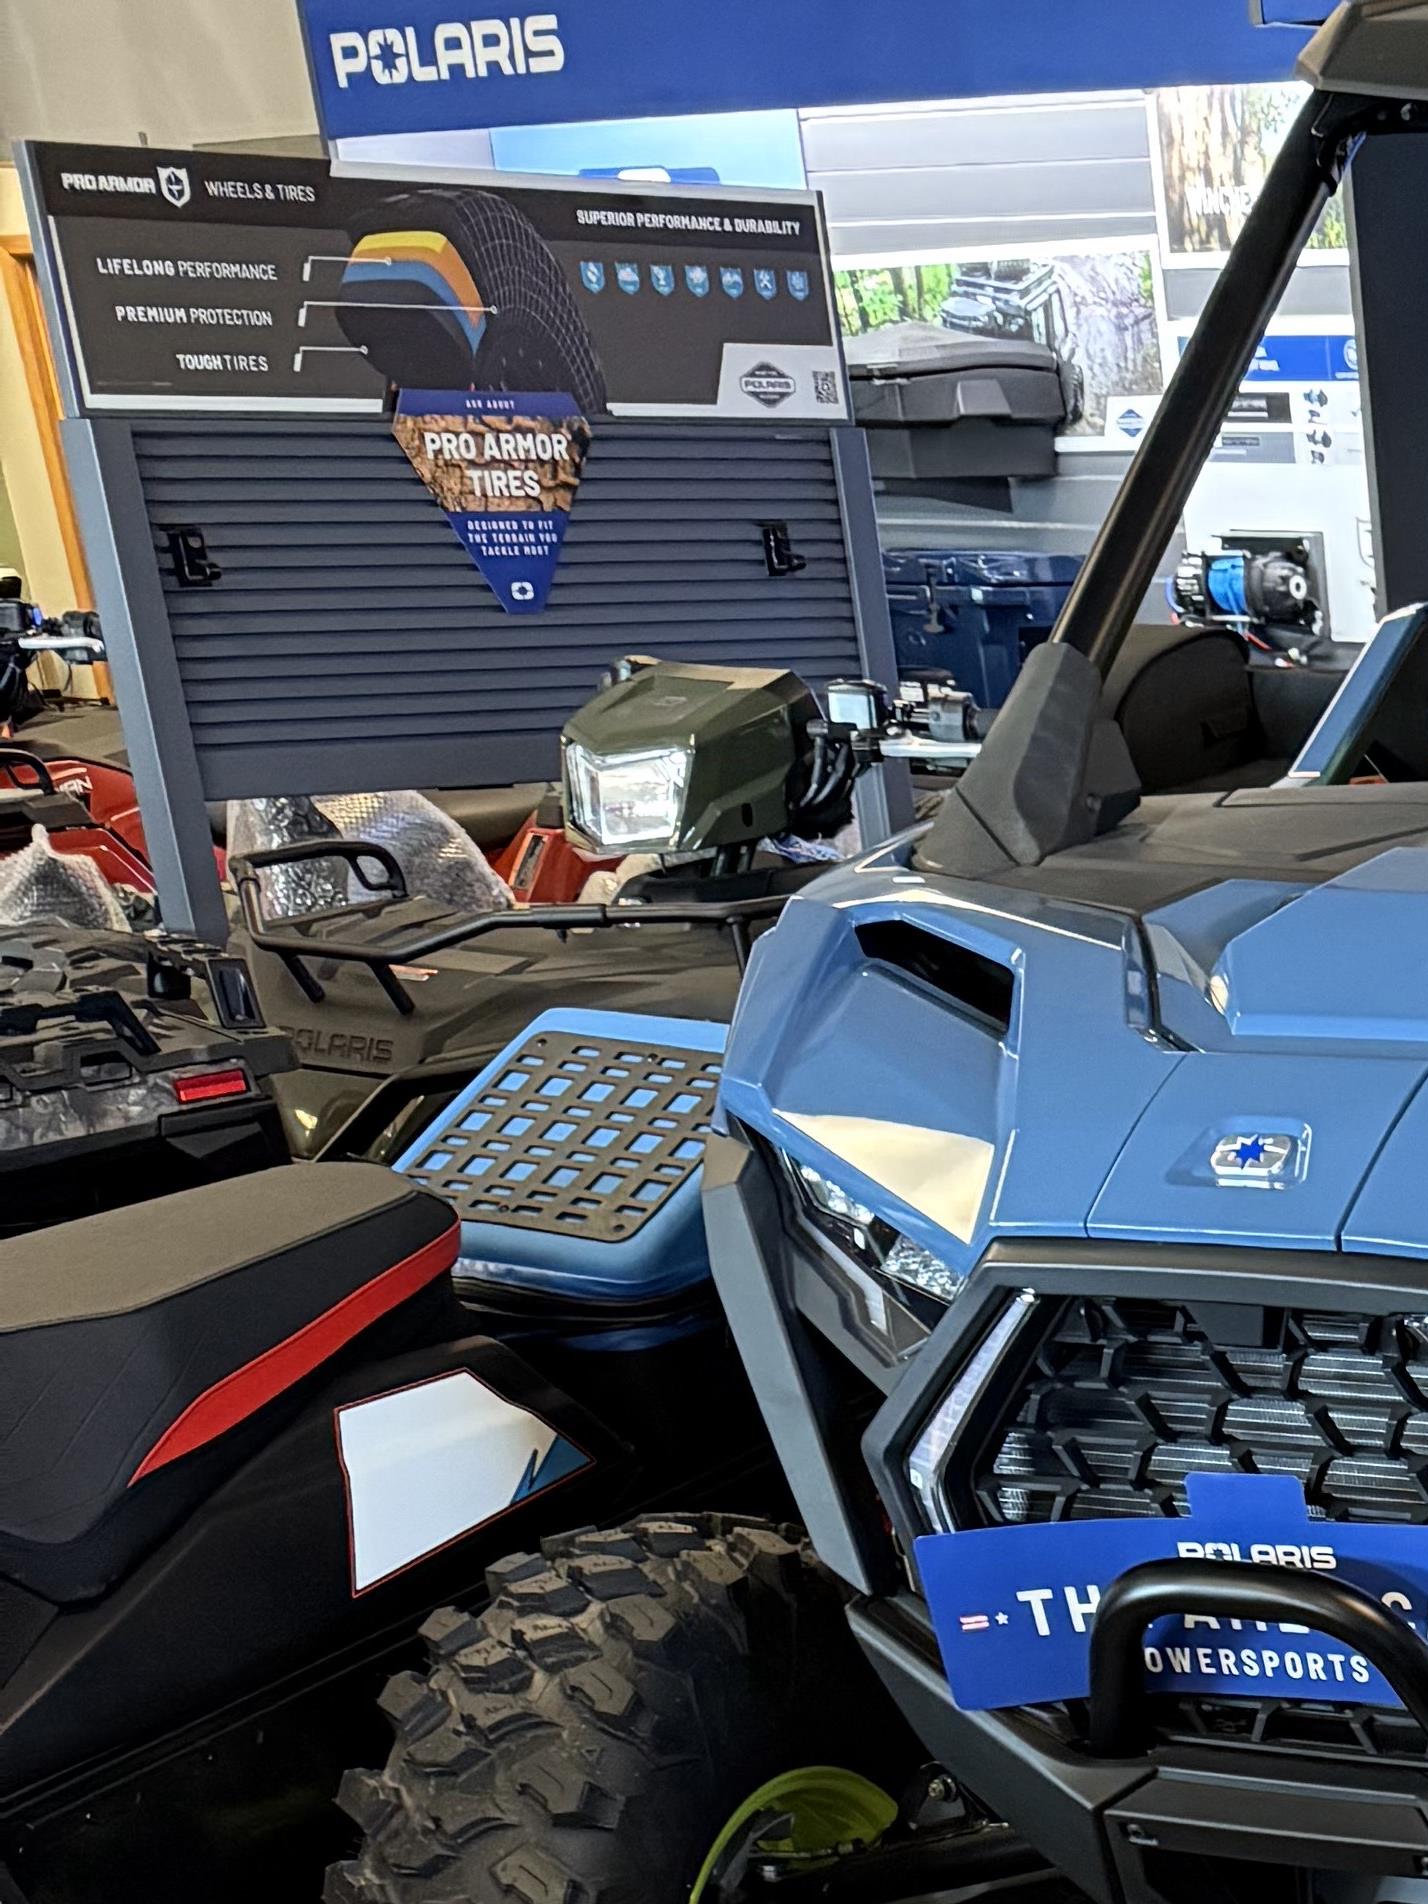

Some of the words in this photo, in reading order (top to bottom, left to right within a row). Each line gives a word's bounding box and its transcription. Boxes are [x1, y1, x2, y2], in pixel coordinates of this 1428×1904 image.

[330, 14, 565, 88] POLARIS
[205, 180, 262, 199] WHEELS
[265, 186, 275, 200] &
[278, 184, 315, 202] TIRES
[1185, 183, 1253, 217] WINCHE
[576, 209, 634, 228] SUPERIOR
[637, 213, 721, 232] PERFORMANCE
[723, 217, 732, 232] &
[734, 217, 800, 236] DURABILITY
[97, 257, 175, 277] LIFELONG
[178, 260, 278, 281] PERFORMANCE
[115, 305, 187, 324] PREMIUM
[190, 307, 273, 326] PROTECTION
[176, 353, 222, 371] TOUGH
[224, 354, 269, 372] TIRES
[424, 432, 477, 460] PRO
[484, 433, 569, 461] ARMOR
[466, 469, 541, 497] TIRES
[467, 520, 518, 530] DESIGNED
[481, 545, 520, 556] TACKLE
[492, 533, 535, 543] TERRAIN
[1017, 1588, 1100, 1638] TH
[1144, 1647, 1370, 1684] OWERSPORTS
